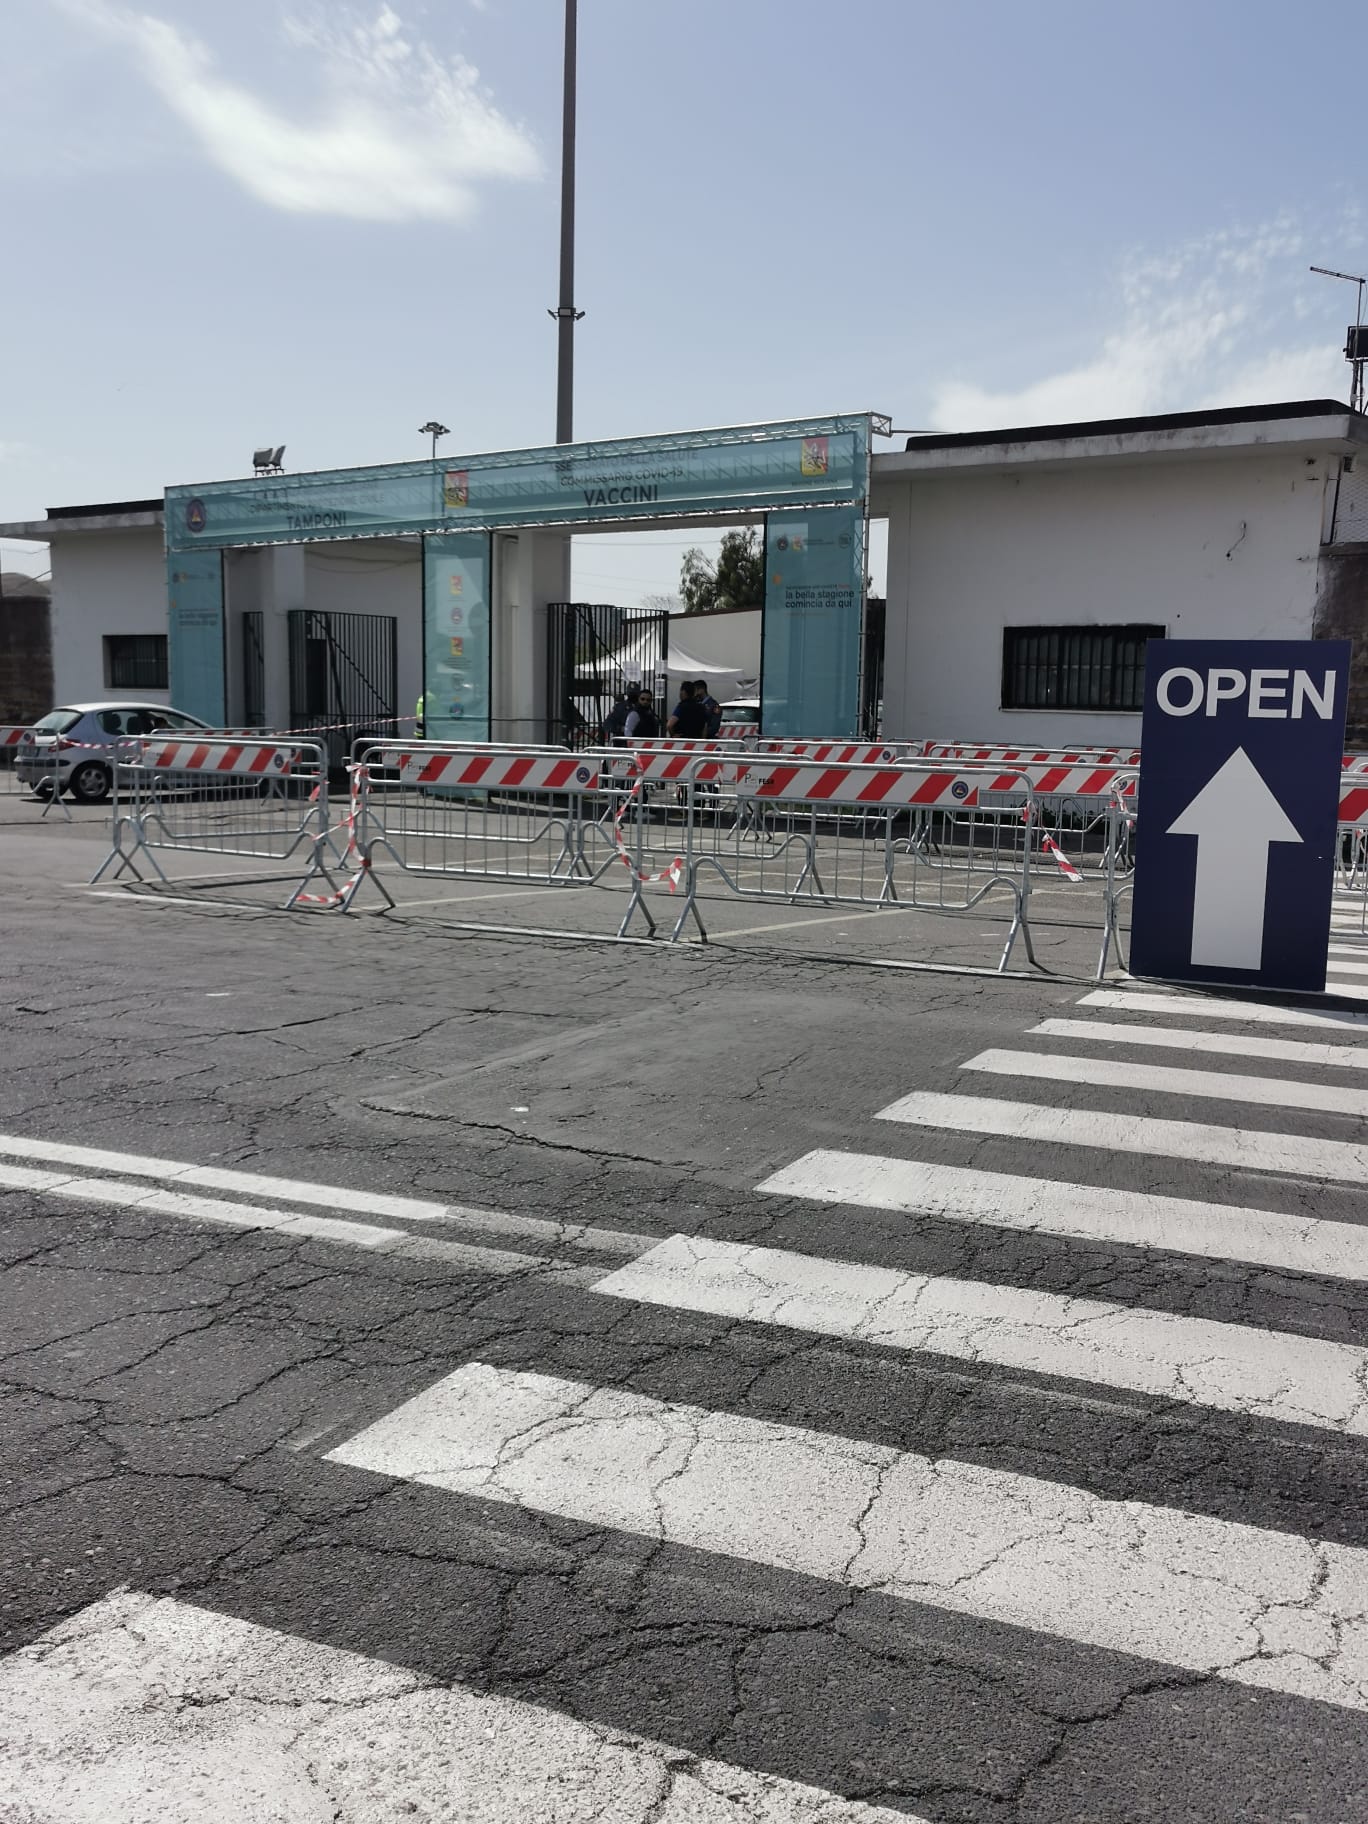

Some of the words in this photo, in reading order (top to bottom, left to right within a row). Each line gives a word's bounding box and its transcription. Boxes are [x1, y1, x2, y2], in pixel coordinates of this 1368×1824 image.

[583, 484, 659, 506] VACCINI
[286, 511, 347, 529] TAMPONI
[785, 599, 823, 608] comincia
[825, 599, 836, 608] da
[838, 599, 852, 608] qui
[795, 590, 815, 599] bella
[818, 590, 855, 599] stagione
[1156, 667, 1337, 719] OPEN
